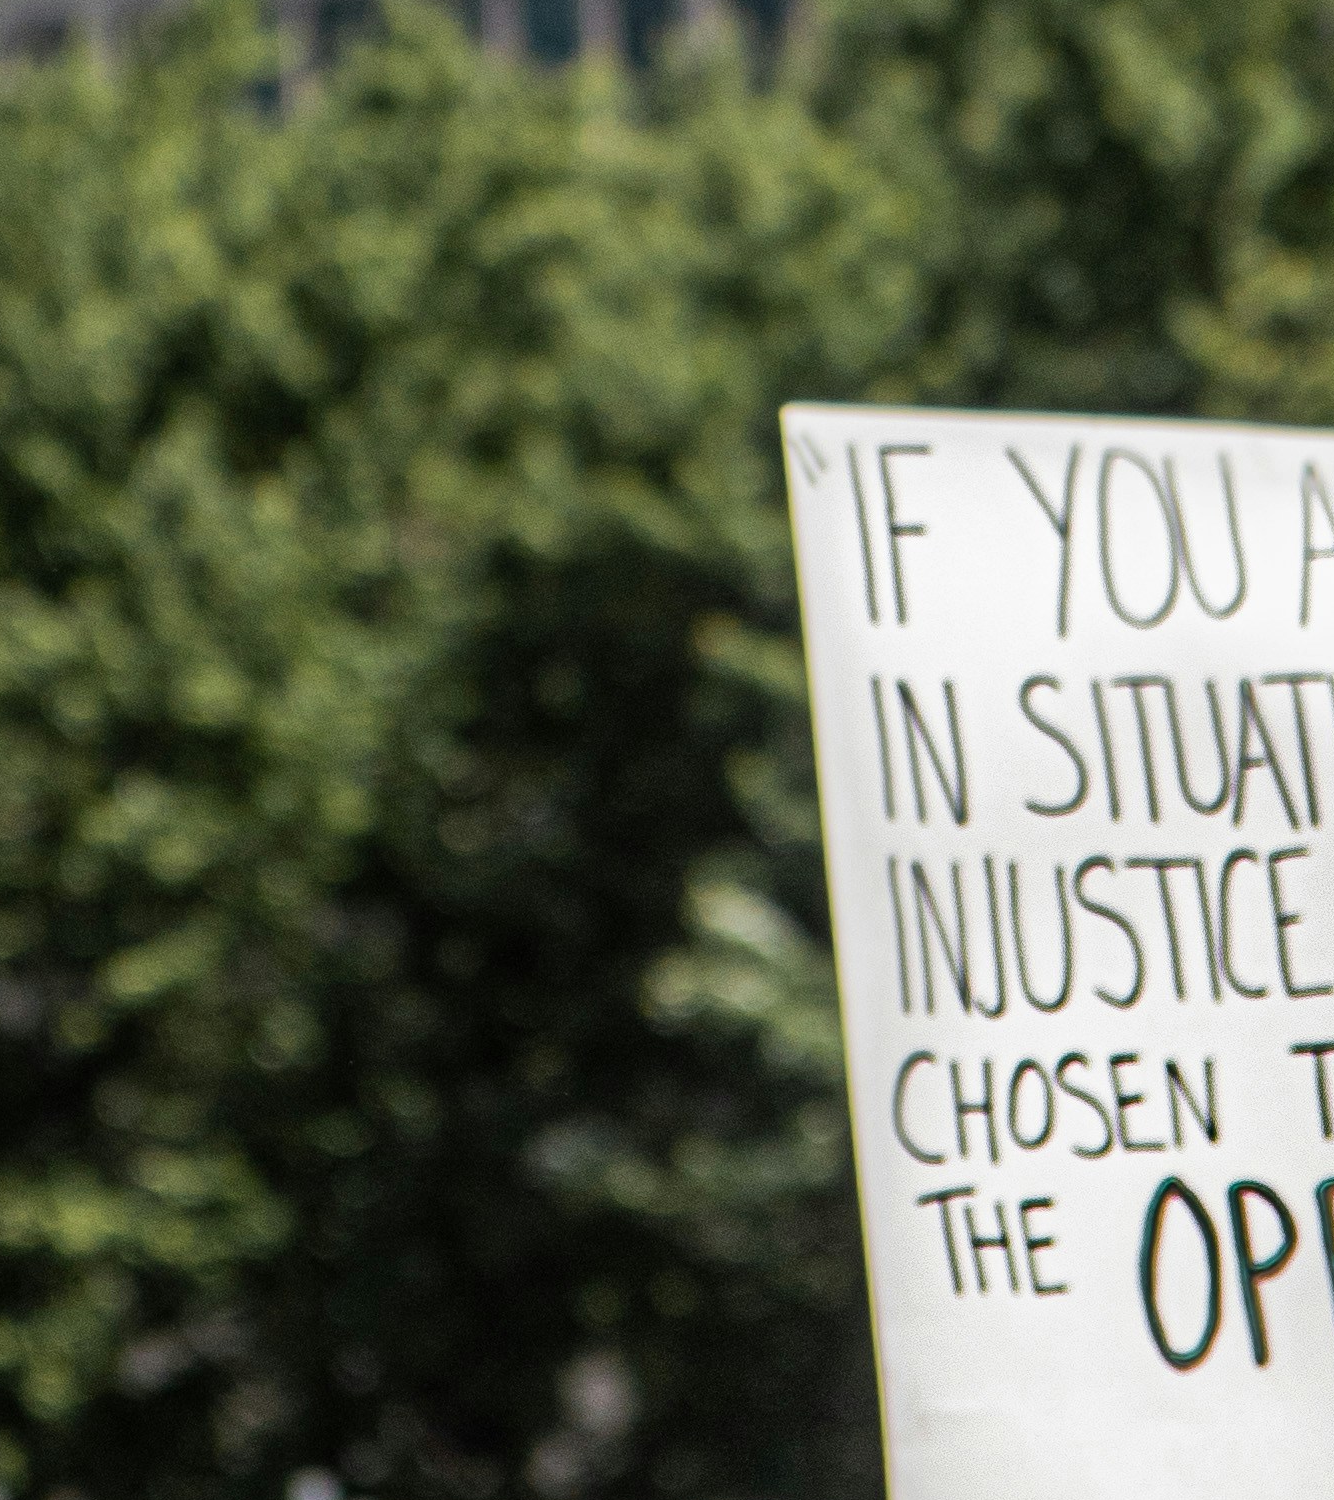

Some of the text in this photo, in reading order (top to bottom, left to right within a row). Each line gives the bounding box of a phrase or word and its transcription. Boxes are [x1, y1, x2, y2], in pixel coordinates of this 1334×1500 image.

[1004, 440, 1250, 640] YOU
[869, 672, 969, 827] IN
[891, 1048, 1223, 1166] CHOSEN
[917, 1183, 1069, 1298] THE
